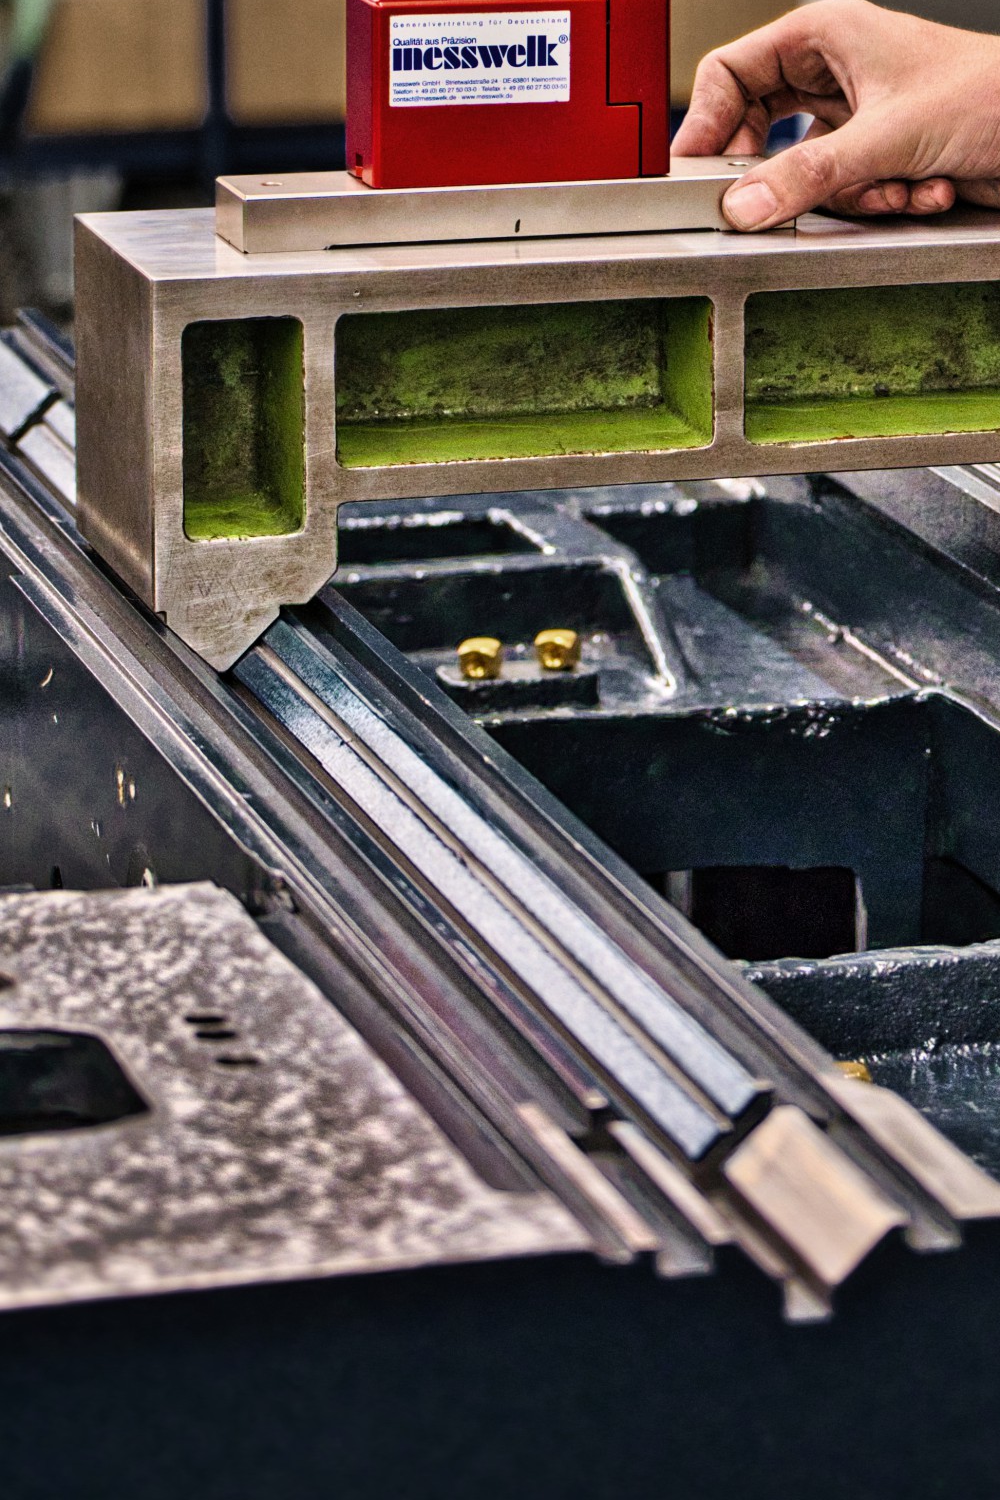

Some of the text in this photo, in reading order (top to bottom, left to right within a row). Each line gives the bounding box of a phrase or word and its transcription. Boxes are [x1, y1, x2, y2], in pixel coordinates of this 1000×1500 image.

[392, 35, 477, 47] Qualität aus Präzision
